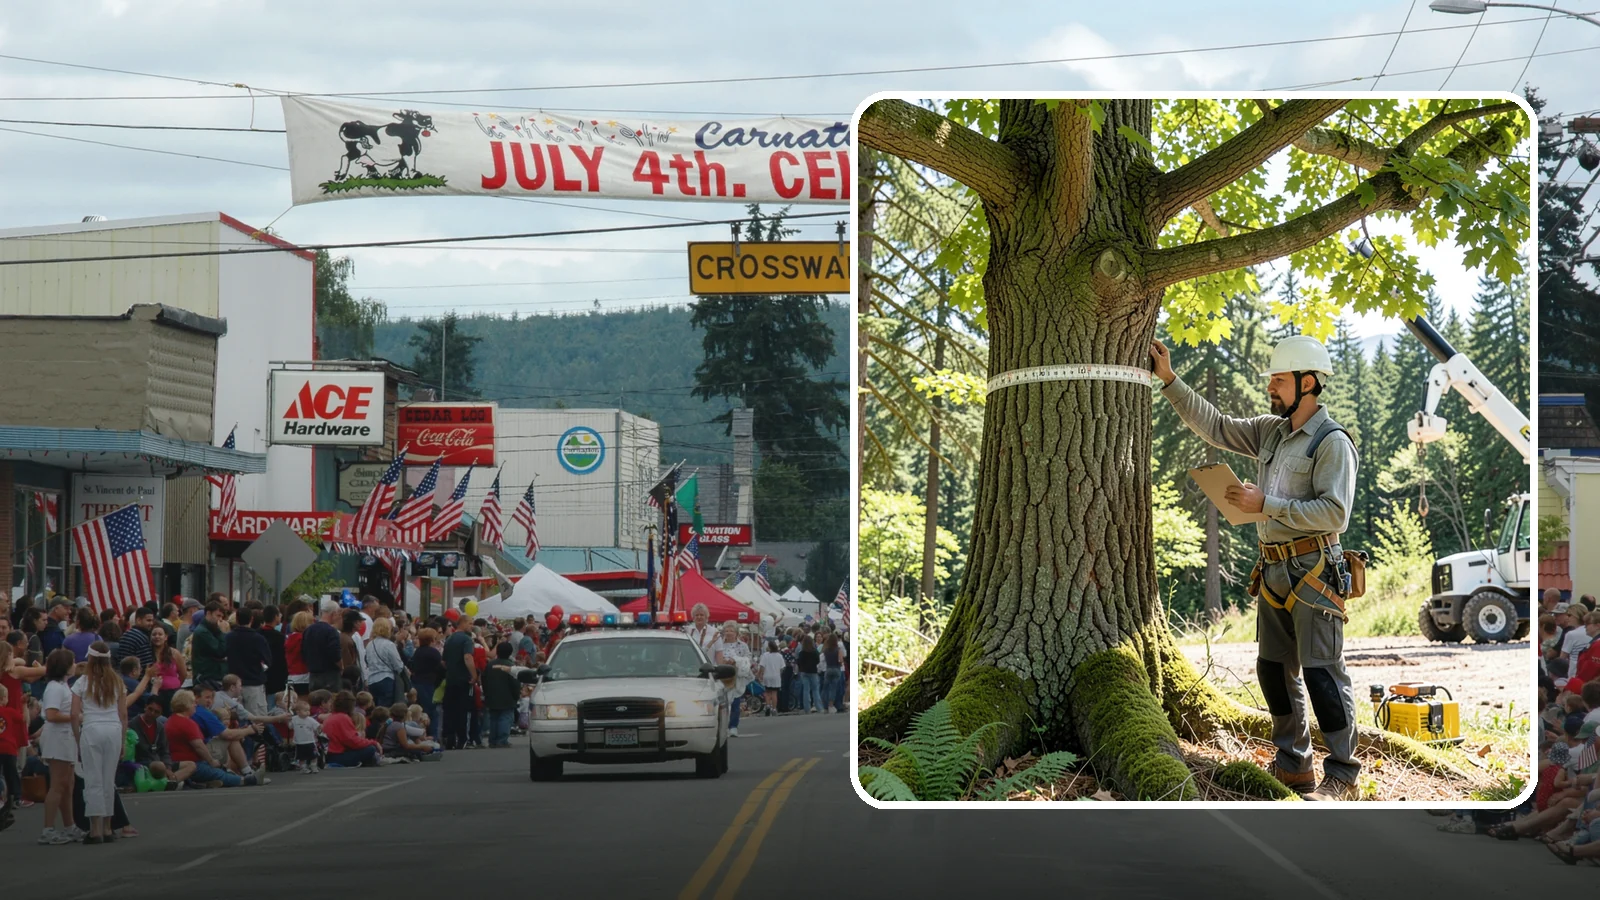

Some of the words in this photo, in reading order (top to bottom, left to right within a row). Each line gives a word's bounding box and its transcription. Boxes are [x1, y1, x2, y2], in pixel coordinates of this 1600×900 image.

[480, 141, 605, 192] JULY
[631, 150, 747, 198] 4th.
[696, 254, 850, 280] CROSSWA
[283, 380, 373, 420] ACE
[406, 409, 453, 422] CEDAR
[283, 421, 371, 436] Hardware
[416, 428, 477, 447] Coca-Cola
[83, 486, 93, 495] St.
[95, 485, 124, 495] Vincent
[126, 486, 136, 495] de
[137, 486, 155, 495] Paul
[699, 535, 730, 543] GLASS
